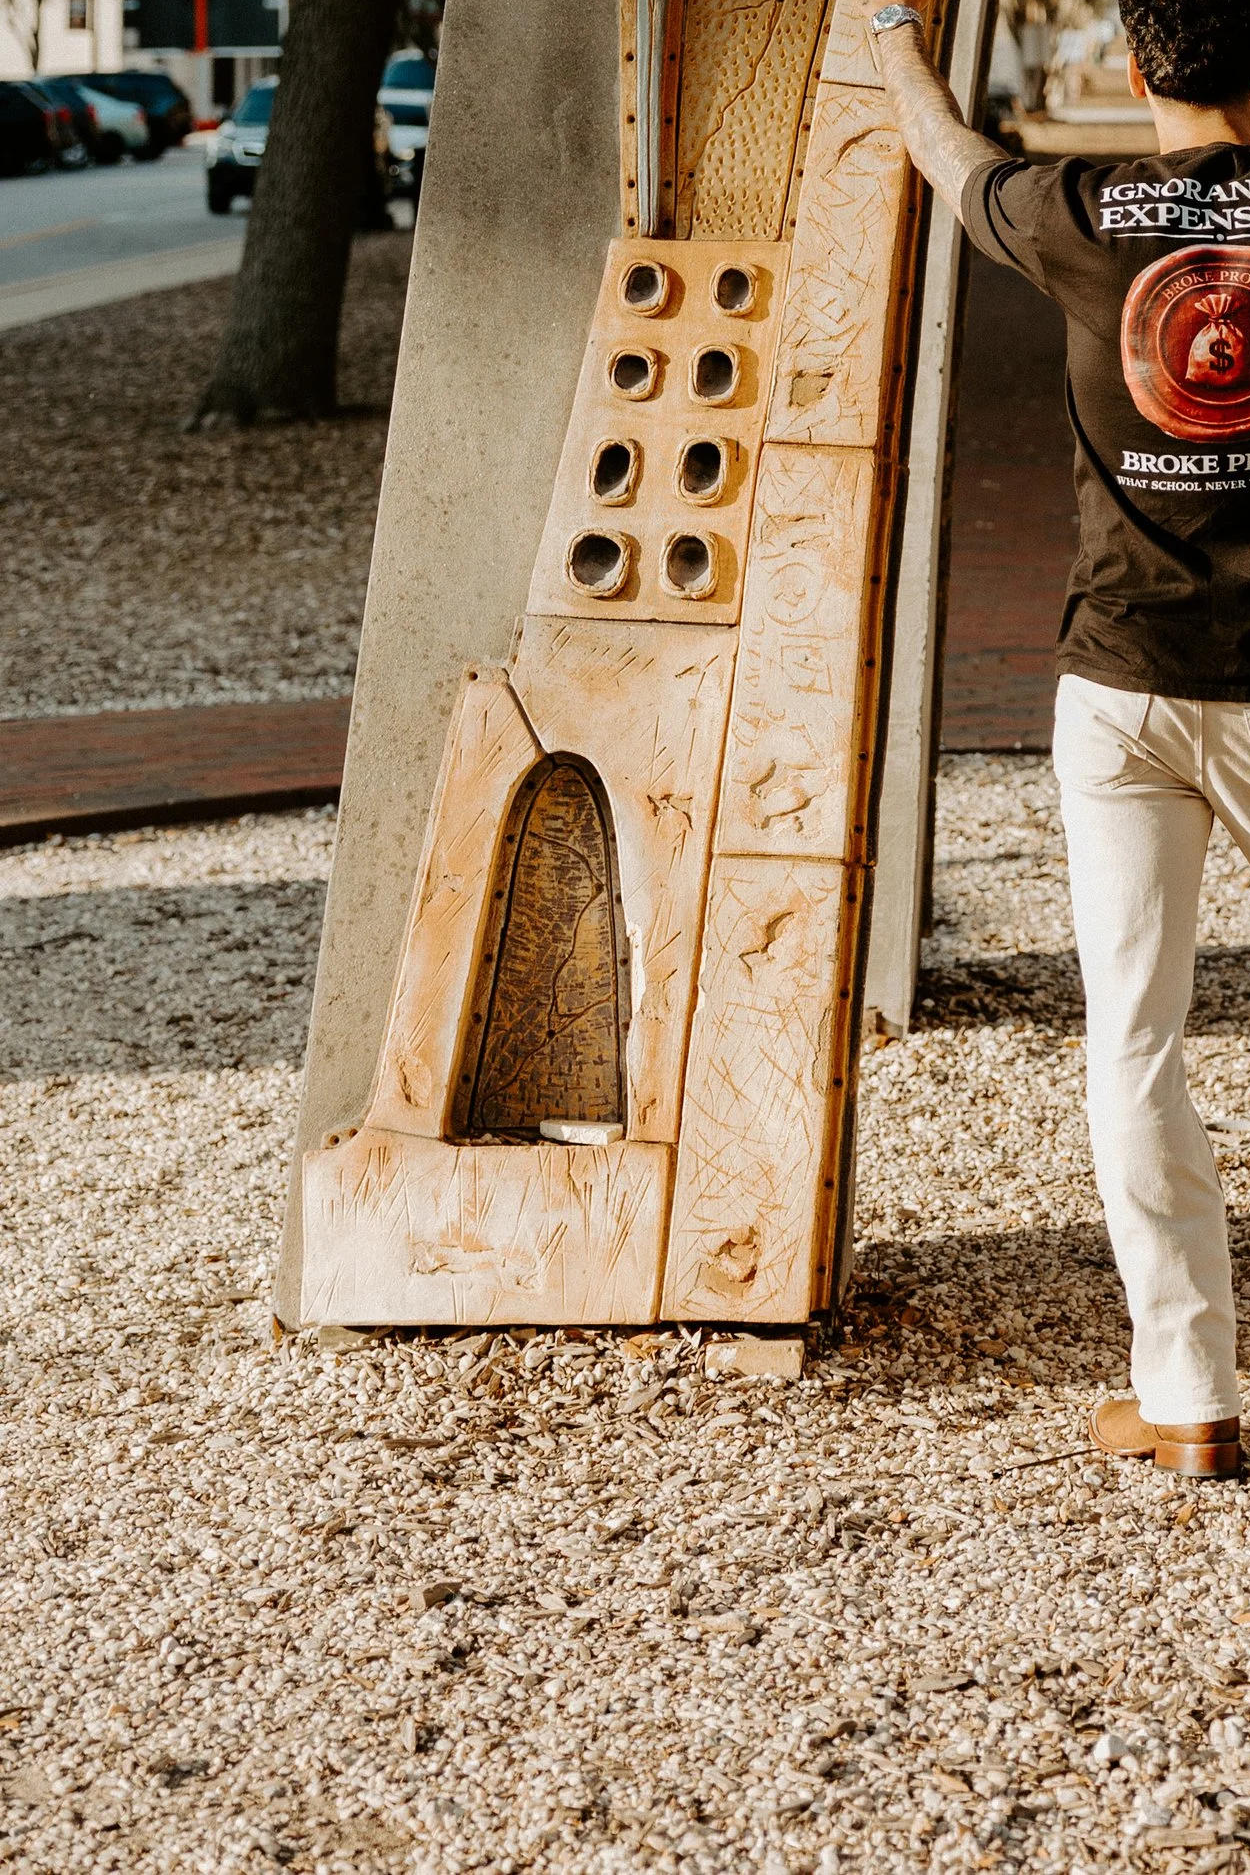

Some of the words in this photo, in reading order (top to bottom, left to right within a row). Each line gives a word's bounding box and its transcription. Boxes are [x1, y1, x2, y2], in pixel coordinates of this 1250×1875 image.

[1162, 271, 1214, 300] BROKE
[1120, 450, 1220, 474] BROKE
[1116, 475, 1149, 489] WHAT
[1151, 480, 1202, 492] SCHOOL
[1205, 480, 1247, 491] NEVER
